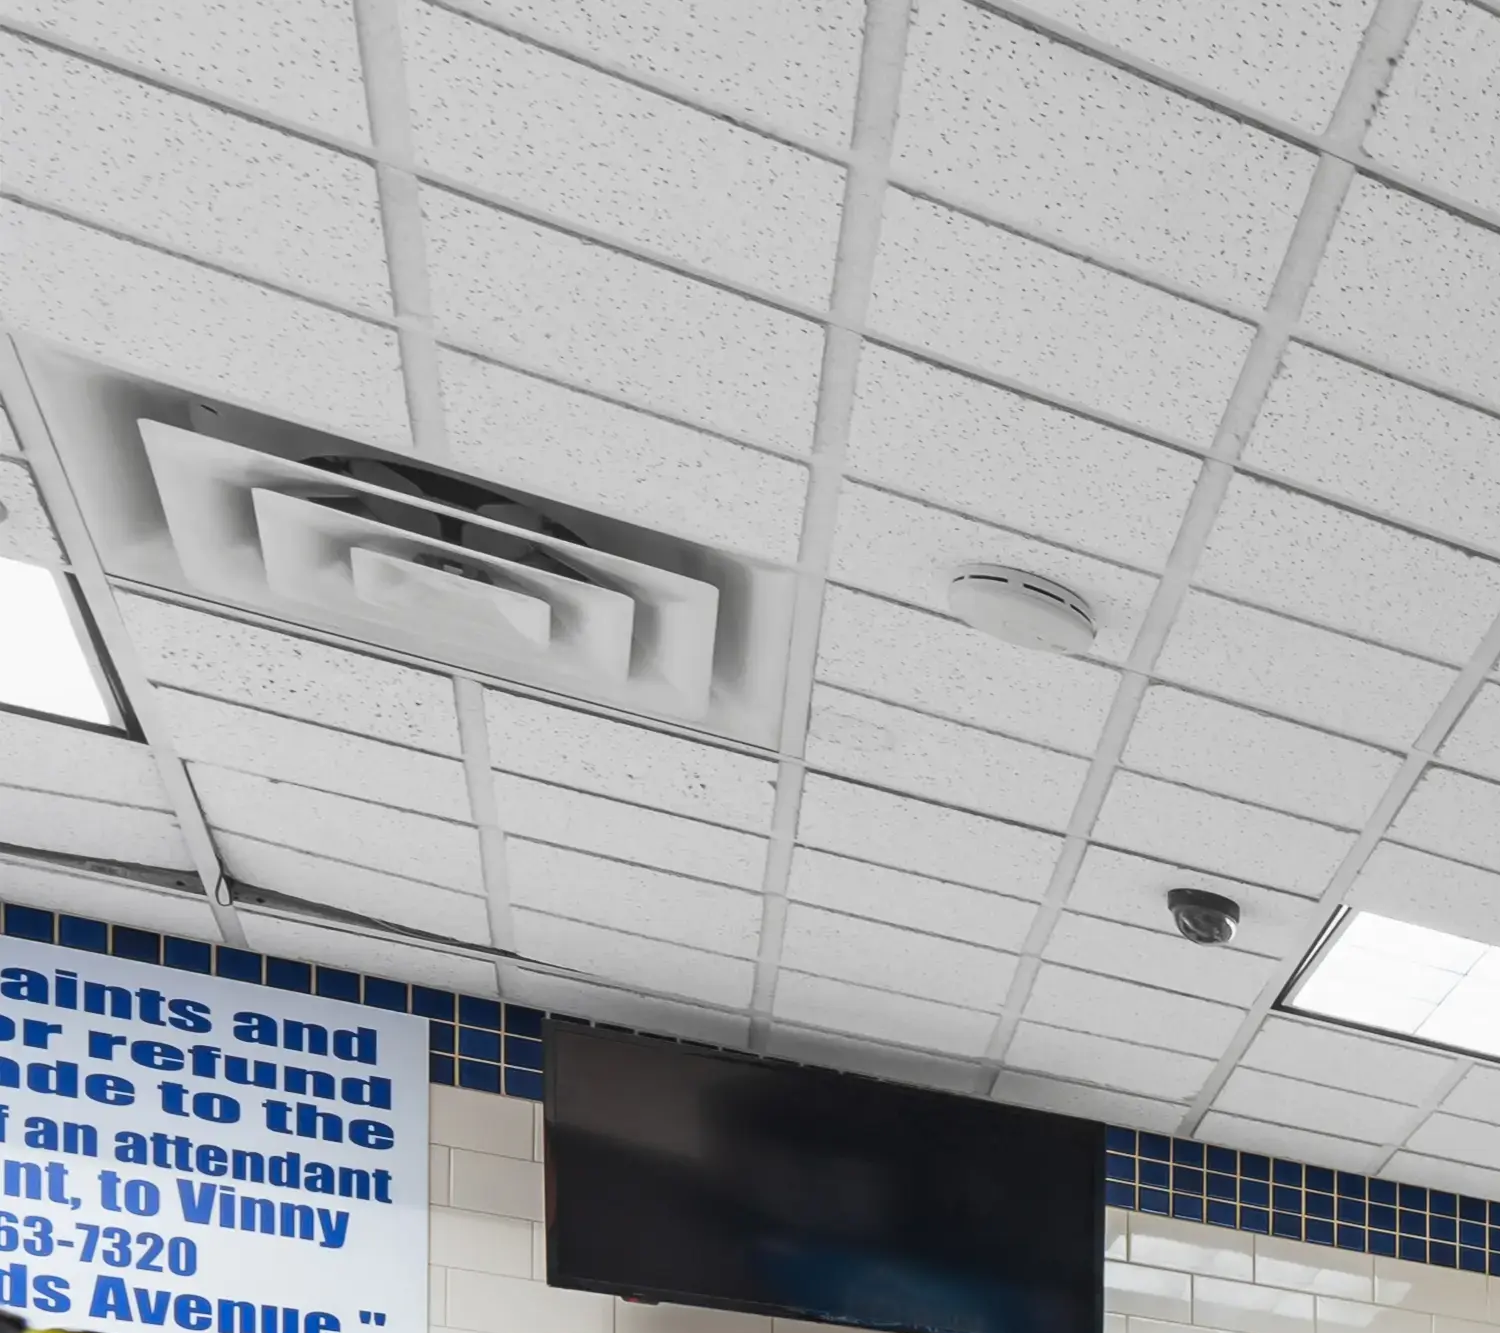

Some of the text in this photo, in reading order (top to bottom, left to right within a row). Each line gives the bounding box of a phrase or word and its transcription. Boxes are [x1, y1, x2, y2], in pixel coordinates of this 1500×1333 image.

[0, 965, 378, 1066] aints and
[88, 1027, 393, 1111] refund
[157, 1080, 241, 1125] to
[262, 1098, 395, 1151] the
[24, 1115, 393, 1205] an attendant
[97, 1170, 160, 1217] to
[176, 1179, 350, 1249] Vinny
